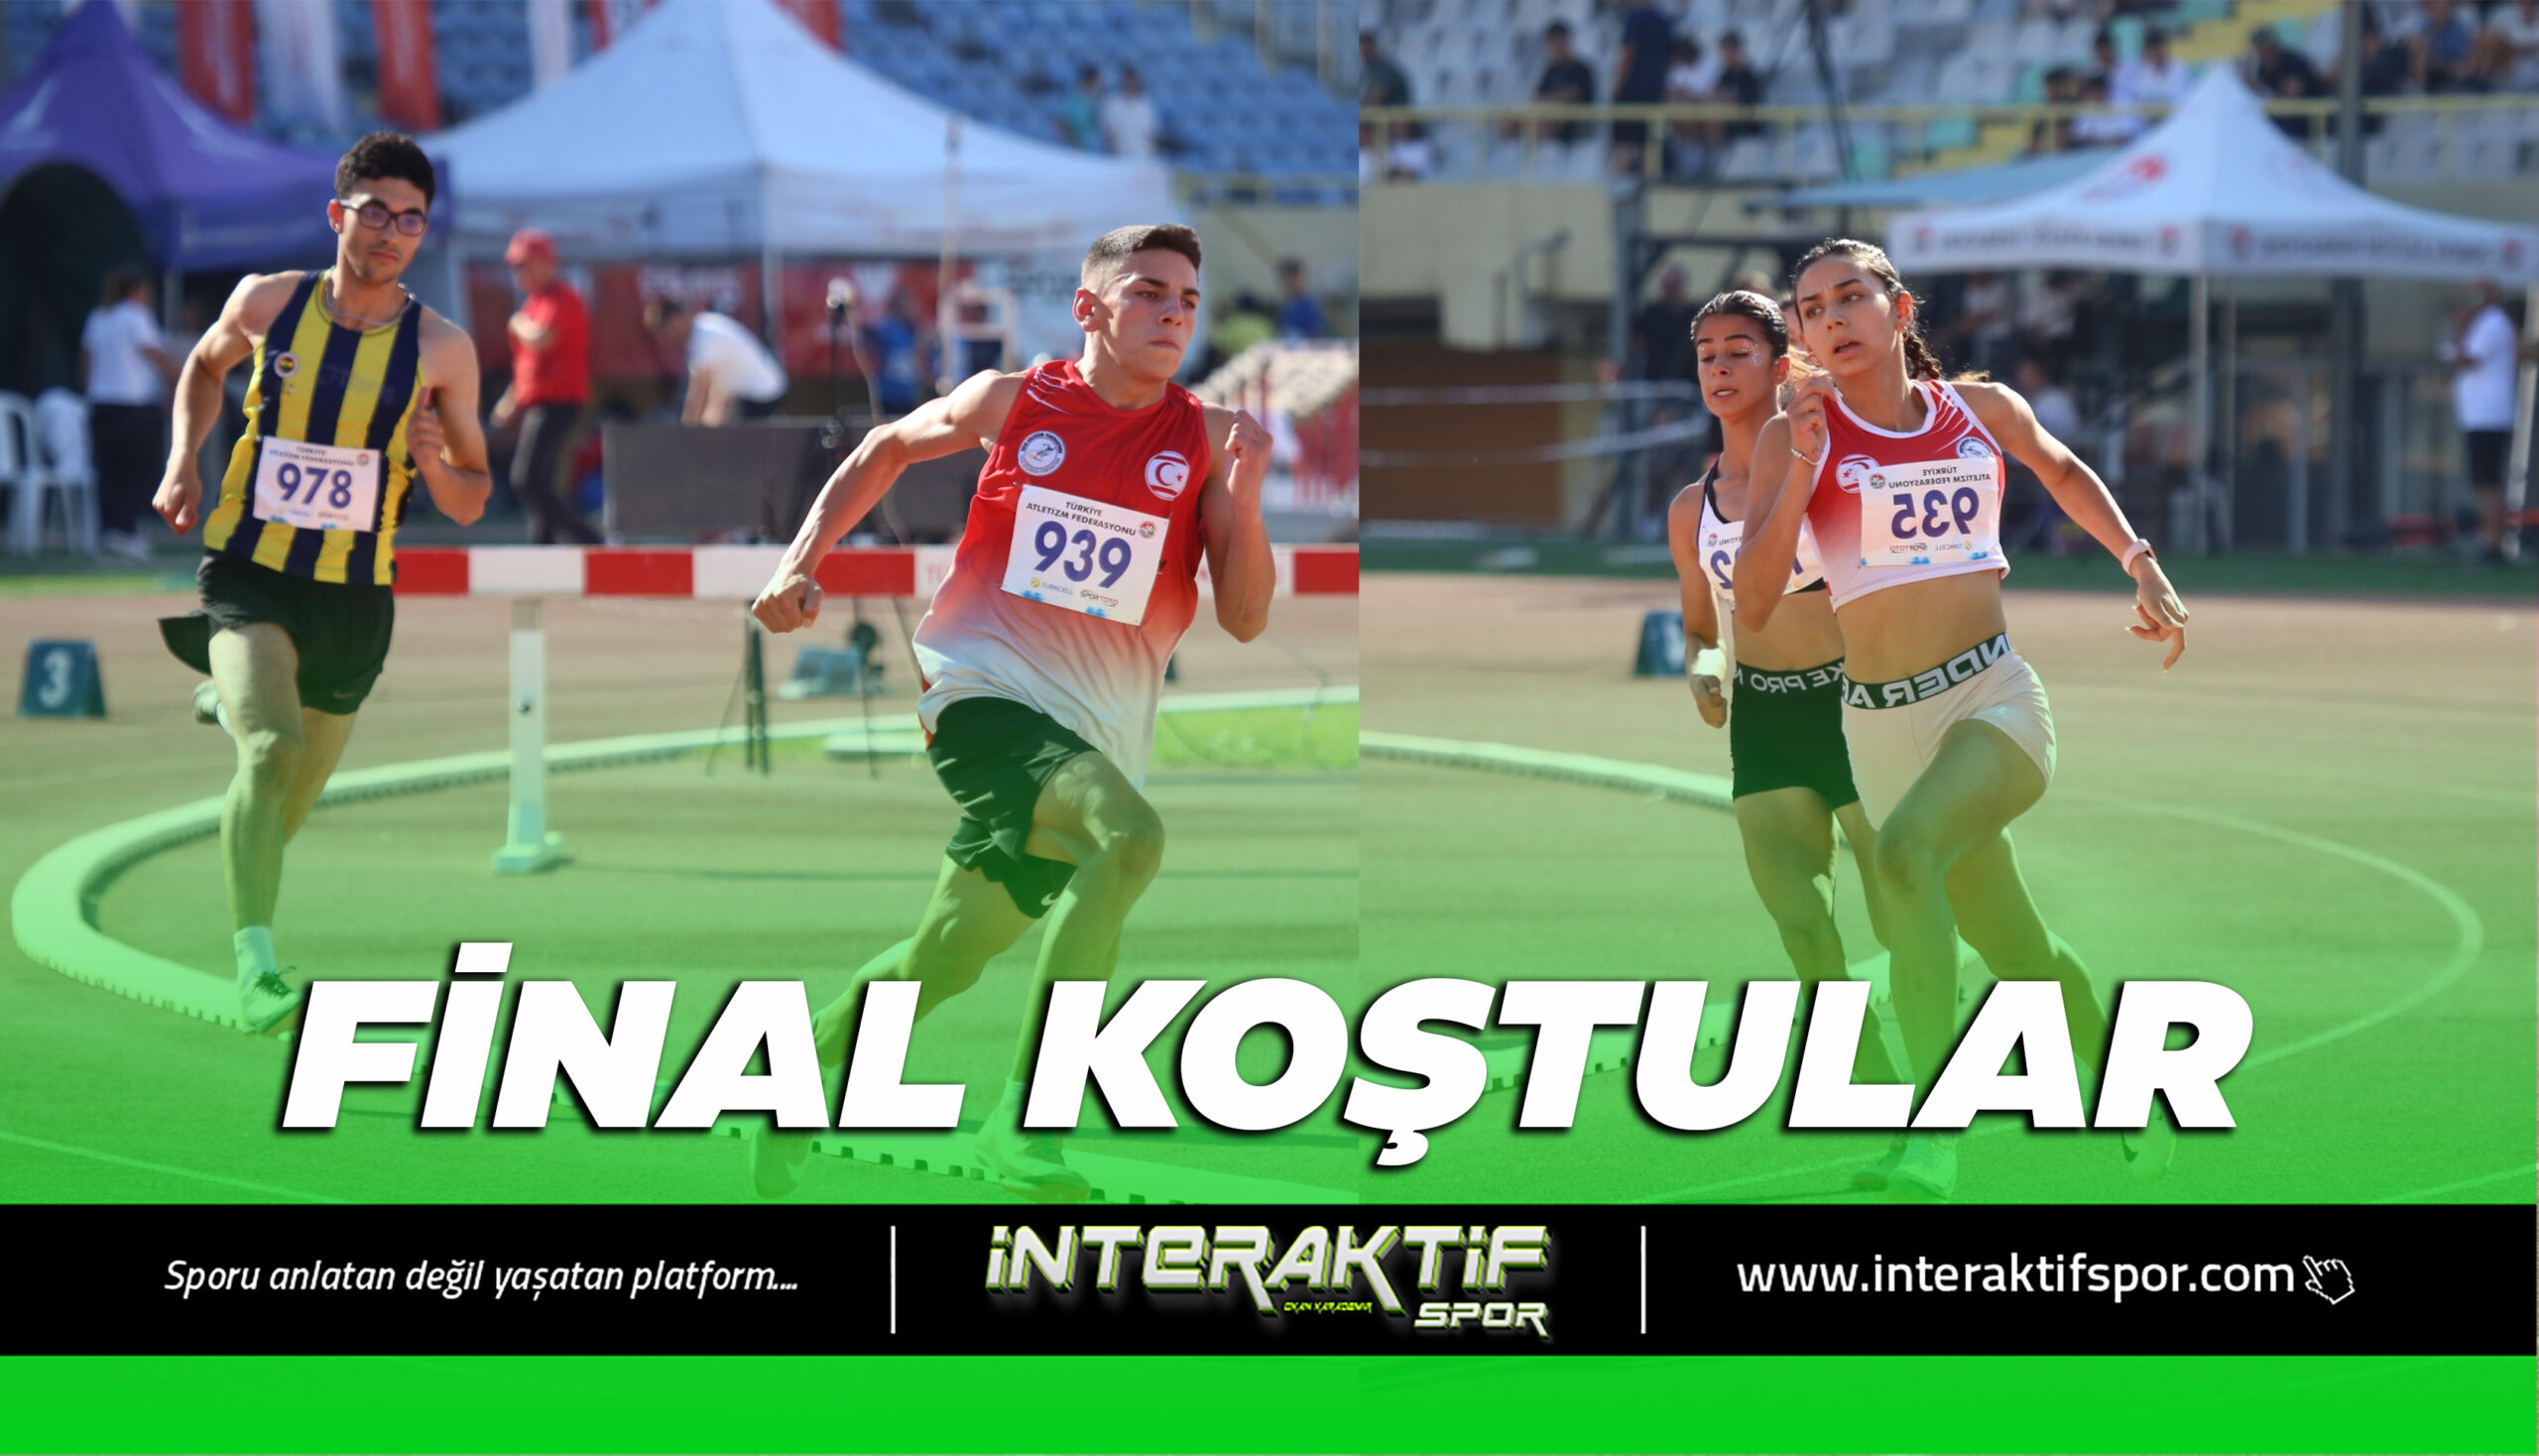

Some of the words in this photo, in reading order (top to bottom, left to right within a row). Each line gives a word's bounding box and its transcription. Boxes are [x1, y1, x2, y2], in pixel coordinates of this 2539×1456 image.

[277, 462, 352, 510] 978
[1065, 501, 1103, 518] TÜRKİYE
[1027, 502, 1069, 519] ATLETİZM
[1071, 513, 1137, 537] FEDERASYONU
[1033, 521, 1132, 589] 939
[40, 649, 72, 708] 3
